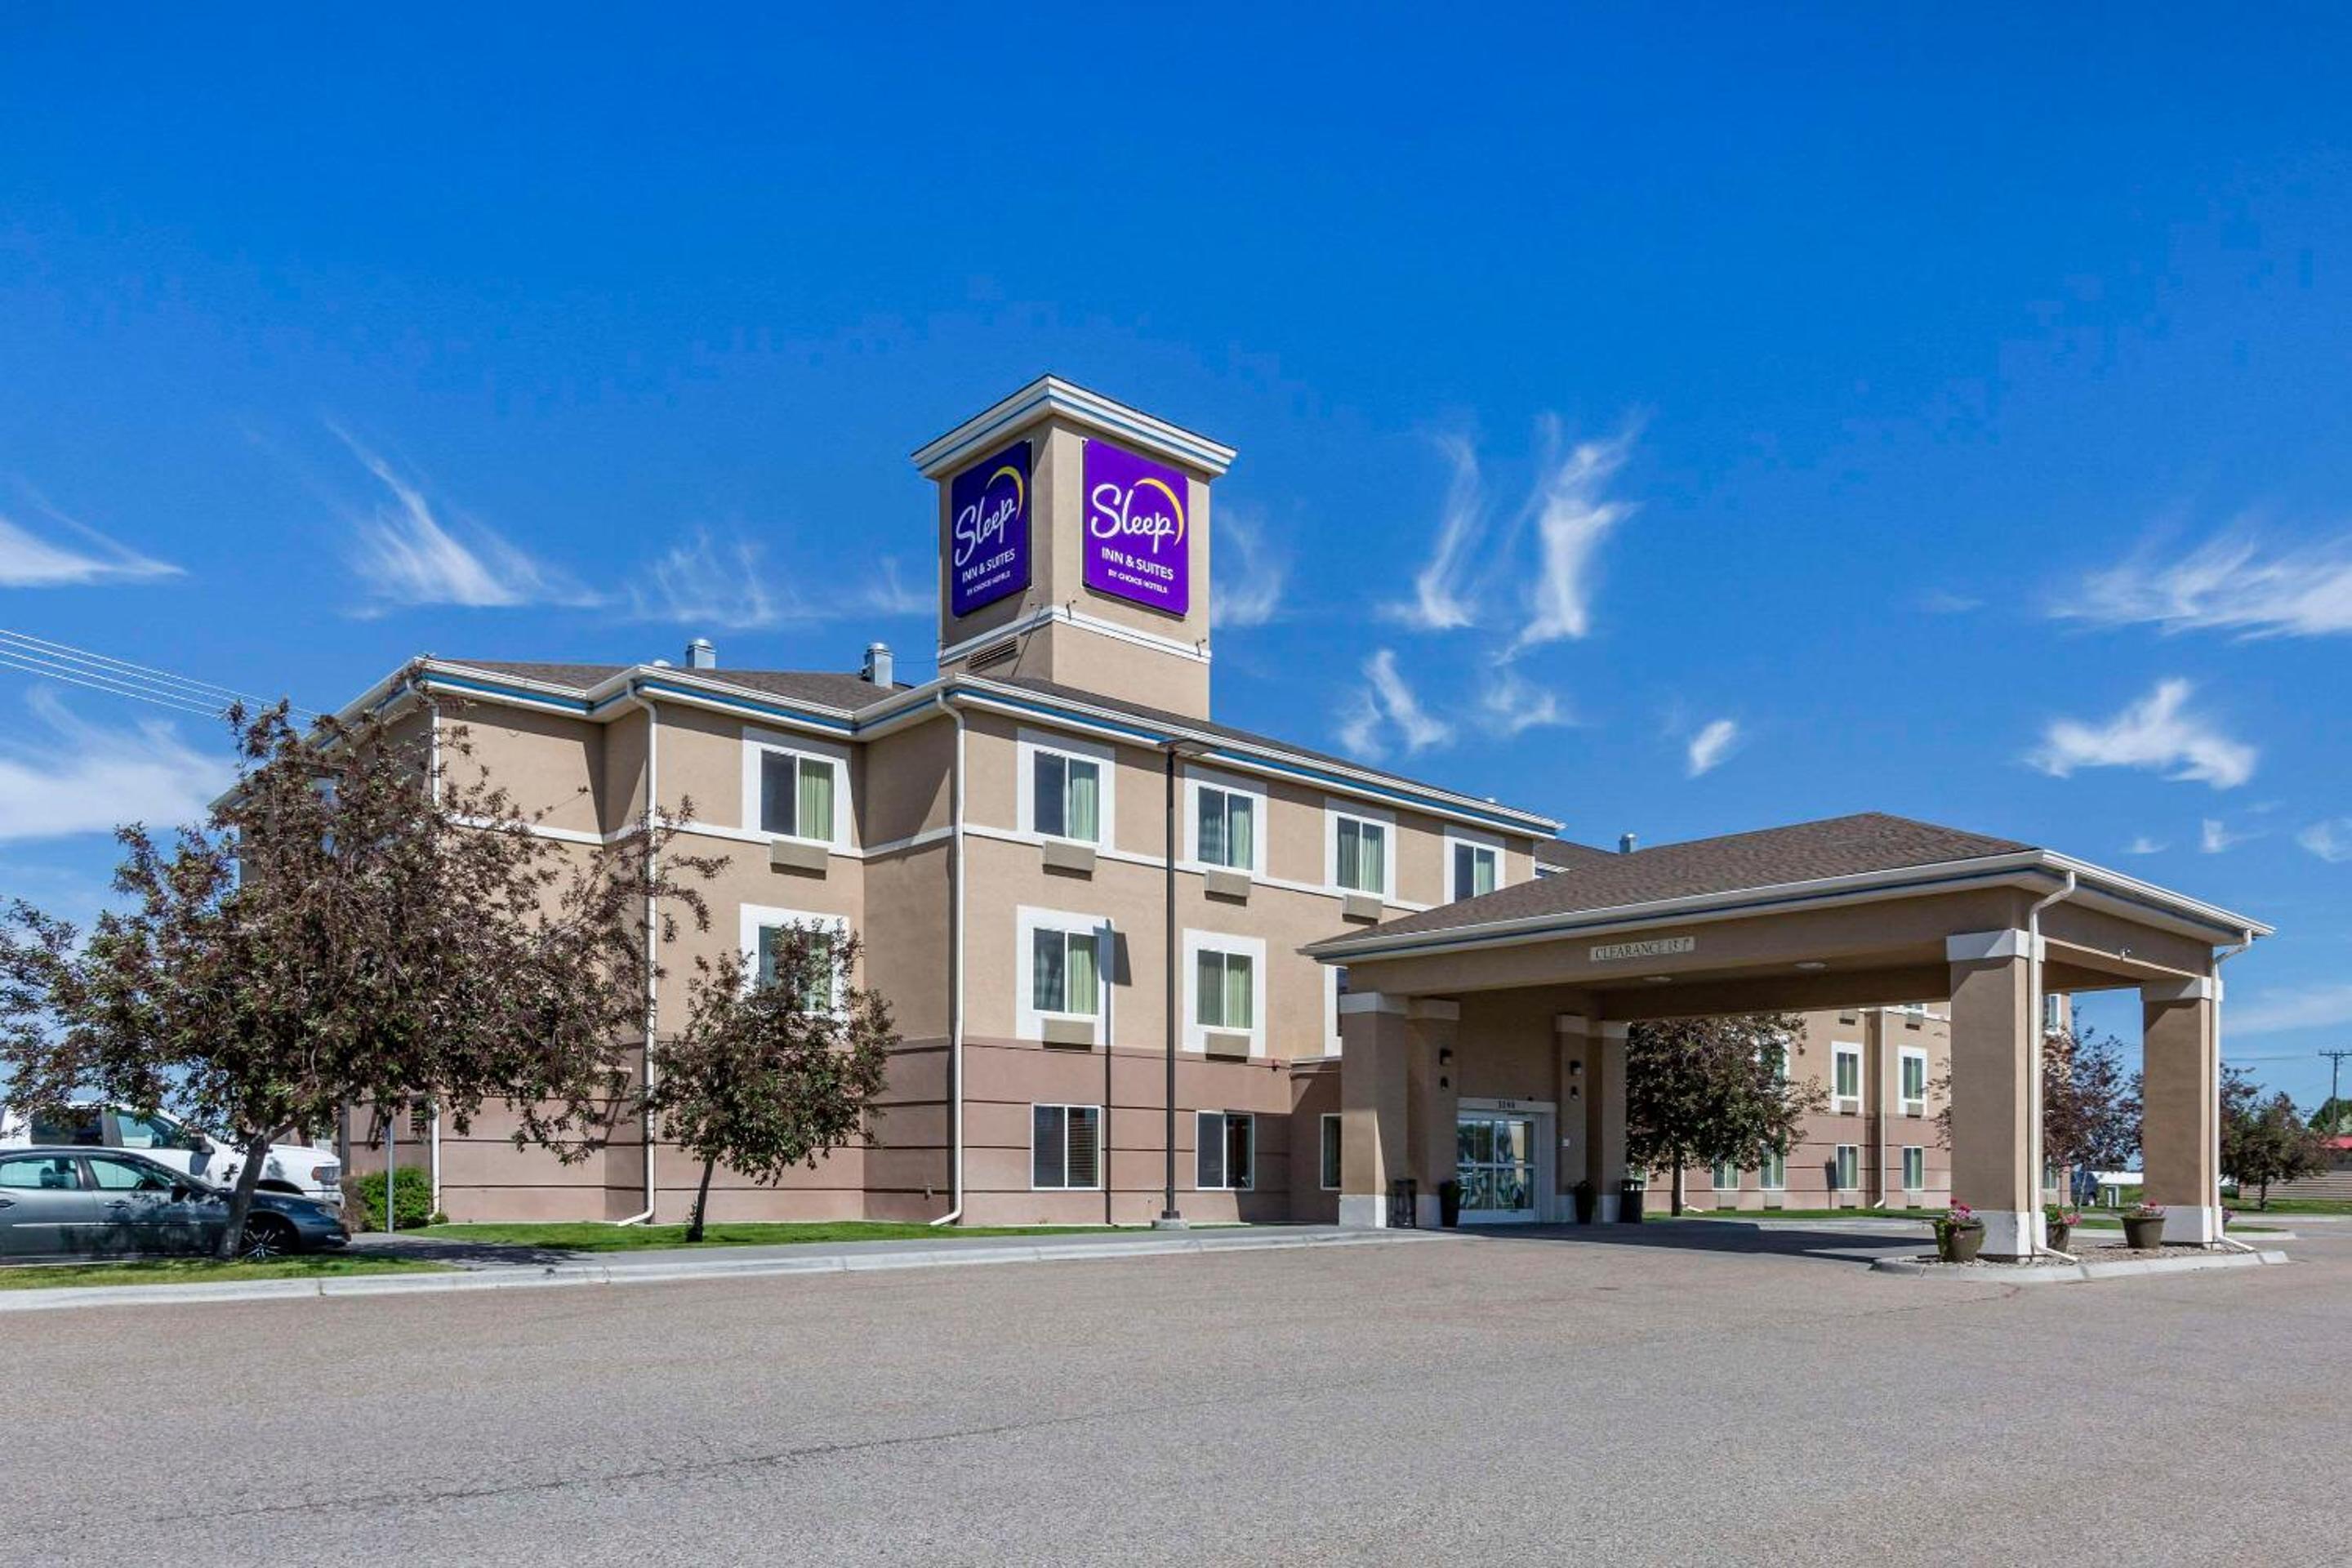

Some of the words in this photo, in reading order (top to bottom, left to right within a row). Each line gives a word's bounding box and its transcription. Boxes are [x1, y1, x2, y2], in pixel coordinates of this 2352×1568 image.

[955, 497, 1017, 567] Sleep
[1091, 483, 1174, 554] Sleep
[962, 566, 978, 584] INN
[979, 563, 985, 575] &
[987, 548, 1015, 571] SUITES
[1102, 546, 1124, 564] INN
[1125, 555, 1134, 568] &
[1136, 559, 1174, 580] SUITES
